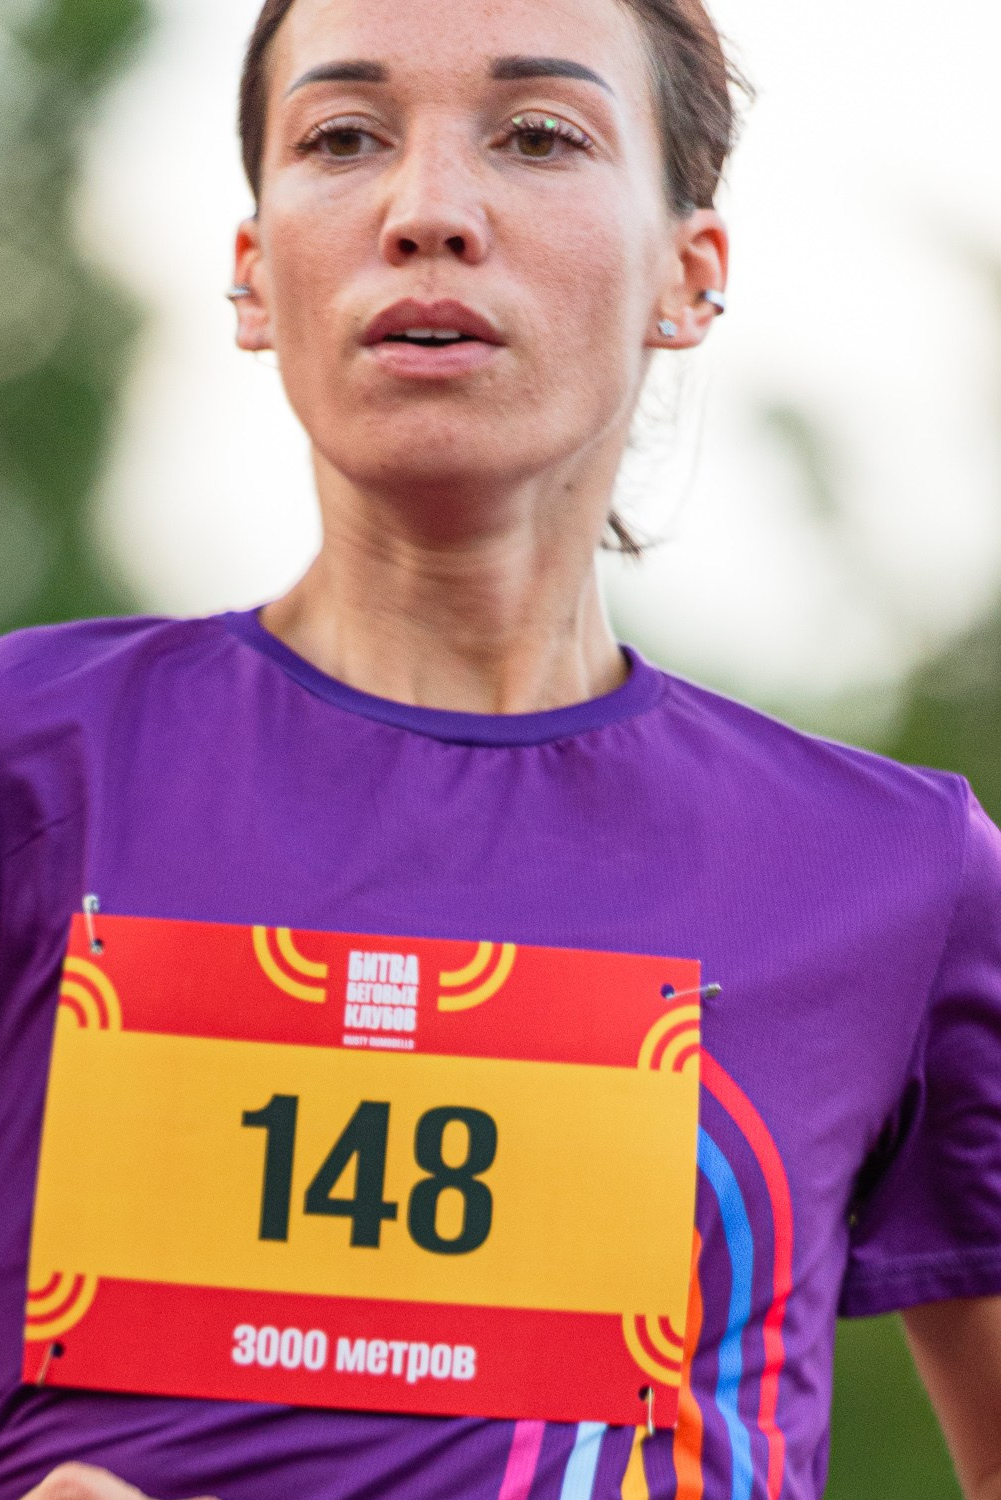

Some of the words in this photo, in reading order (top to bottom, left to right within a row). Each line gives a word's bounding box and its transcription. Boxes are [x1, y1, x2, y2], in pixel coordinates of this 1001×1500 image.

[348, 951, 418, 985] БИТВА
[346, 981, 417, 1006] БЕГОВЫХ
[344, 1003, 416, 1032] КЛУБОВ
[241, 1093, 499, 1256] 148
[232, 1324, 327, 1371] 3000
[335, 1337, 477, 1384] метров
